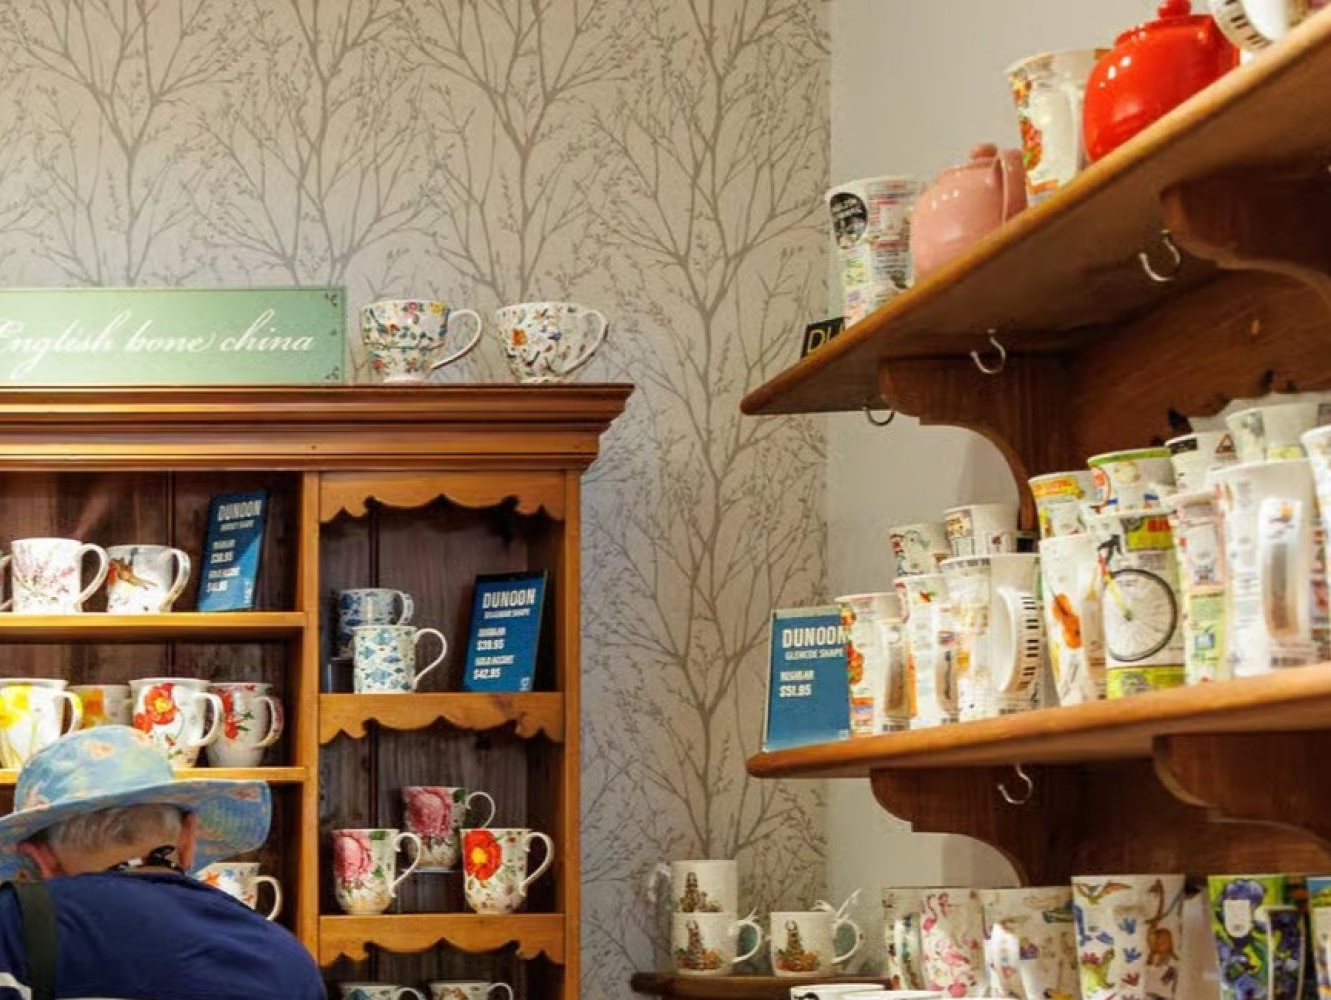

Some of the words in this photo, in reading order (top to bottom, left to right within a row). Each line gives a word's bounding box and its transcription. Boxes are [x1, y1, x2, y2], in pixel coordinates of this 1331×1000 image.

[126, 319, 217, 353] bone
[219, 309, 315, 351] china
[218, 500, 262, 521] DUNOON
[482, 588, 536, 609] DUNOON
